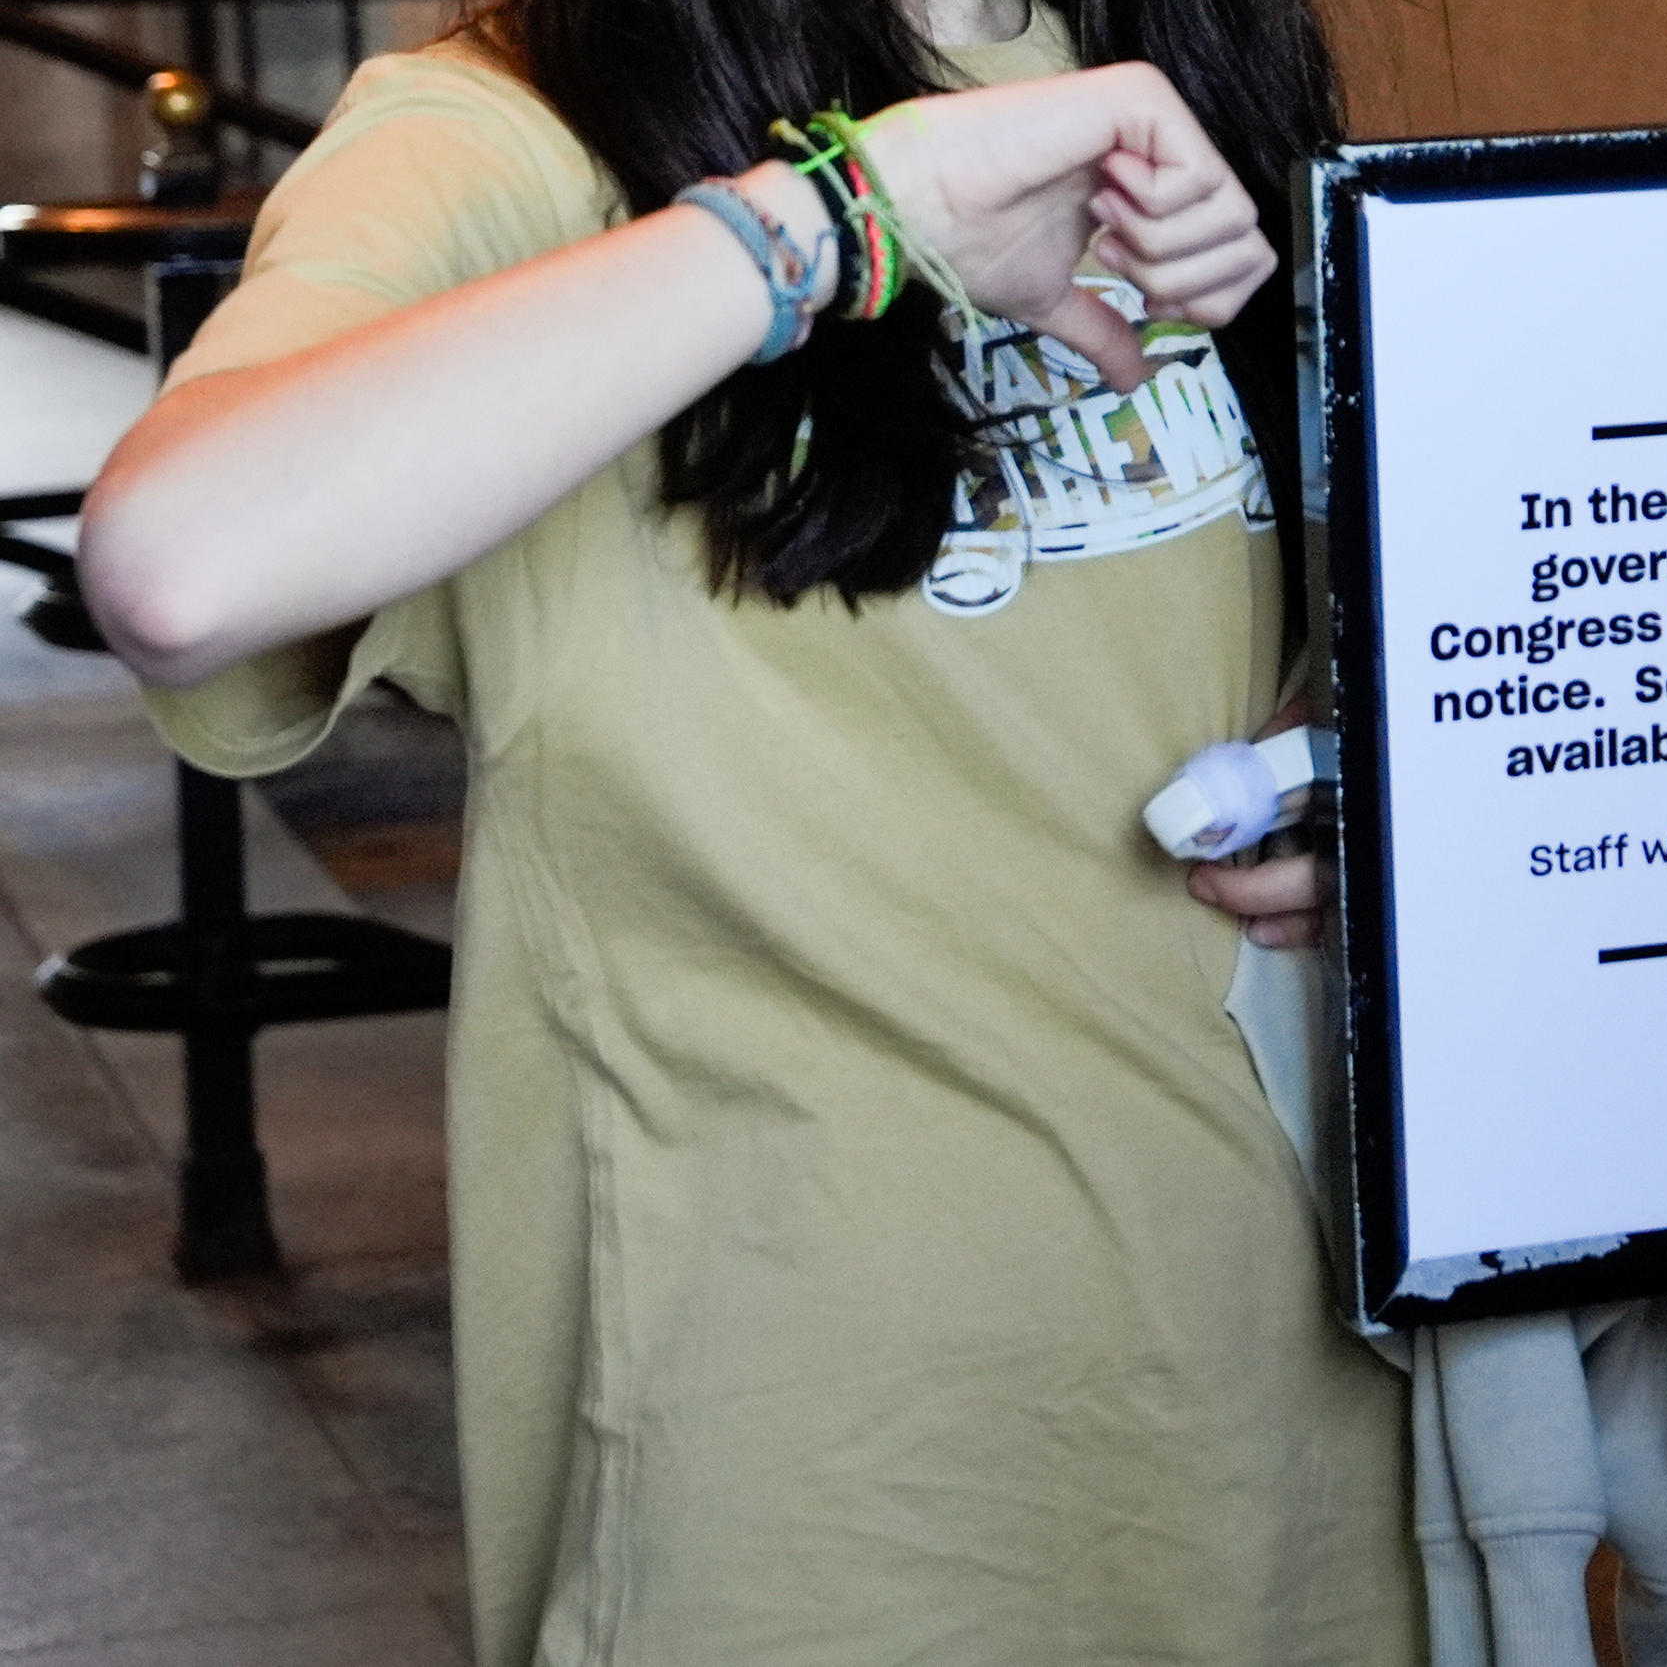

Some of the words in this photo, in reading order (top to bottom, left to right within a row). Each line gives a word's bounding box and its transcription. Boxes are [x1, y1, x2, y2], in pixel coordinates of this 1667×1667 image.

[1521, 493, 1572, 530] In
[1430, 611, 1662, 665] Congress
[1434, 673, 1605, 723] notice.
[1530, 832, 1629, 877] Staff
